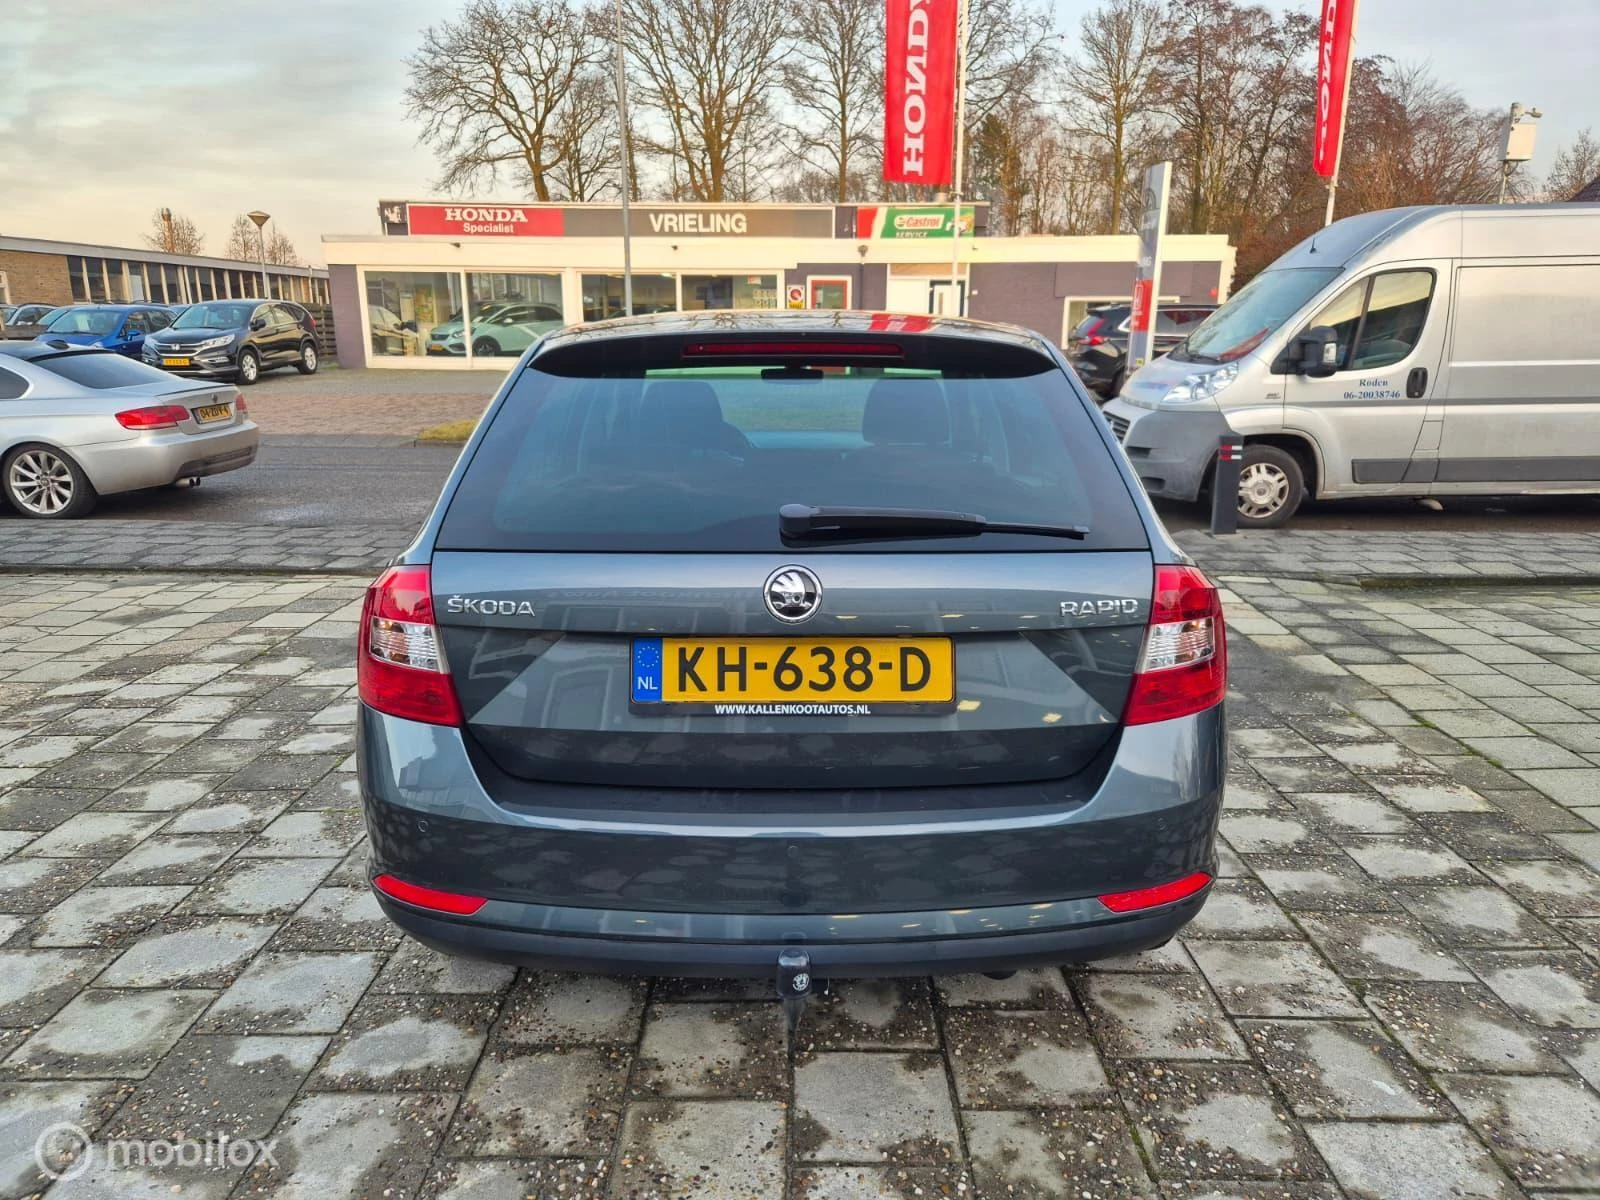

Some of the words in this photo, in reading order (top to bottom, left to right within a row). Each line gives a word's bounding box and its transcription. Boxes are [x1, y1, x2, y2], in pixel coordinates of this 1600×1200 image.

[903, 0, 930, 177] HOND
[444, 208, 528, 222] HONDA
[906, 216, 940, 228] Castrol
[463, 223, 514, 233] Specialist
[649, 213, 748, 233] VRIELING
[1359, 379, 1388, 388] Roden
[1343, 390, 1401, 400] 06-20038746
[447, 594, 536, 617] ŠKODA
[1060, 599, 1139, 616] RAPID
[678, 646, 931, 692] KH-638-D
[637, 676, 658, 690] NL
[715, 704, 871, 715] WWW.KALLENKOOTAUTOS.NL
